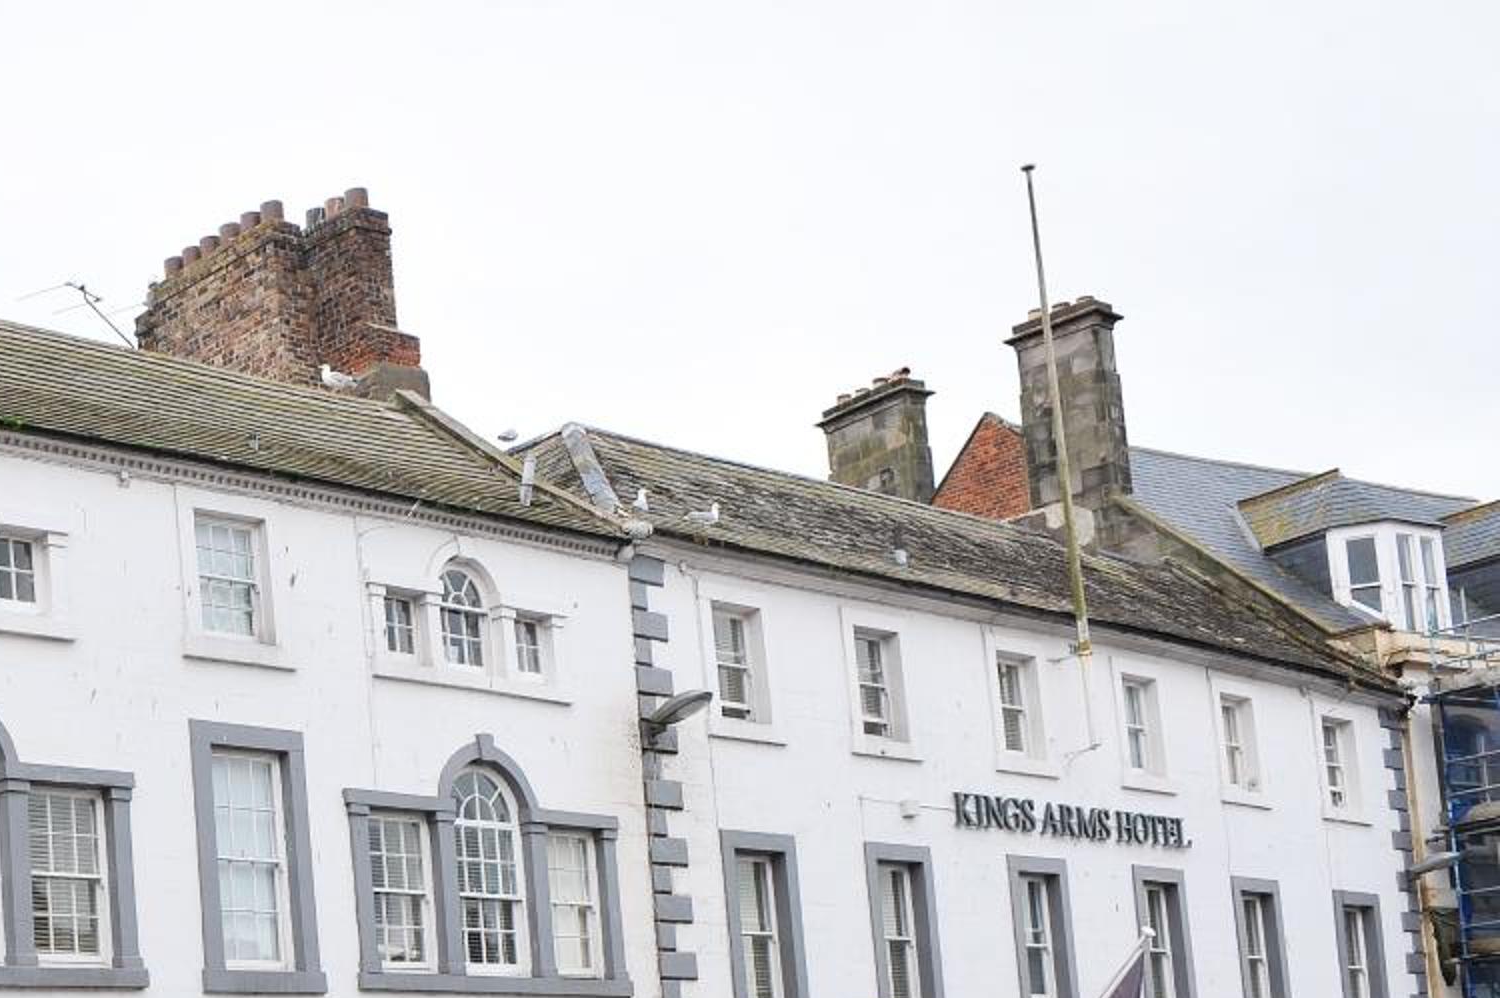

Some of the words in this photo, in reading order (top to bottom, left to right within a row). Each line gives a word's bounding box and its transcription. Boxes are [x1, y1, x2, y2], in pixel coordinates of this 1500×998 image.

[953, 792, 1036, 833] KINGS
[1040, 802, 1111, 842] ARMS
[1115, 810, 1193, 849] HOTEL
